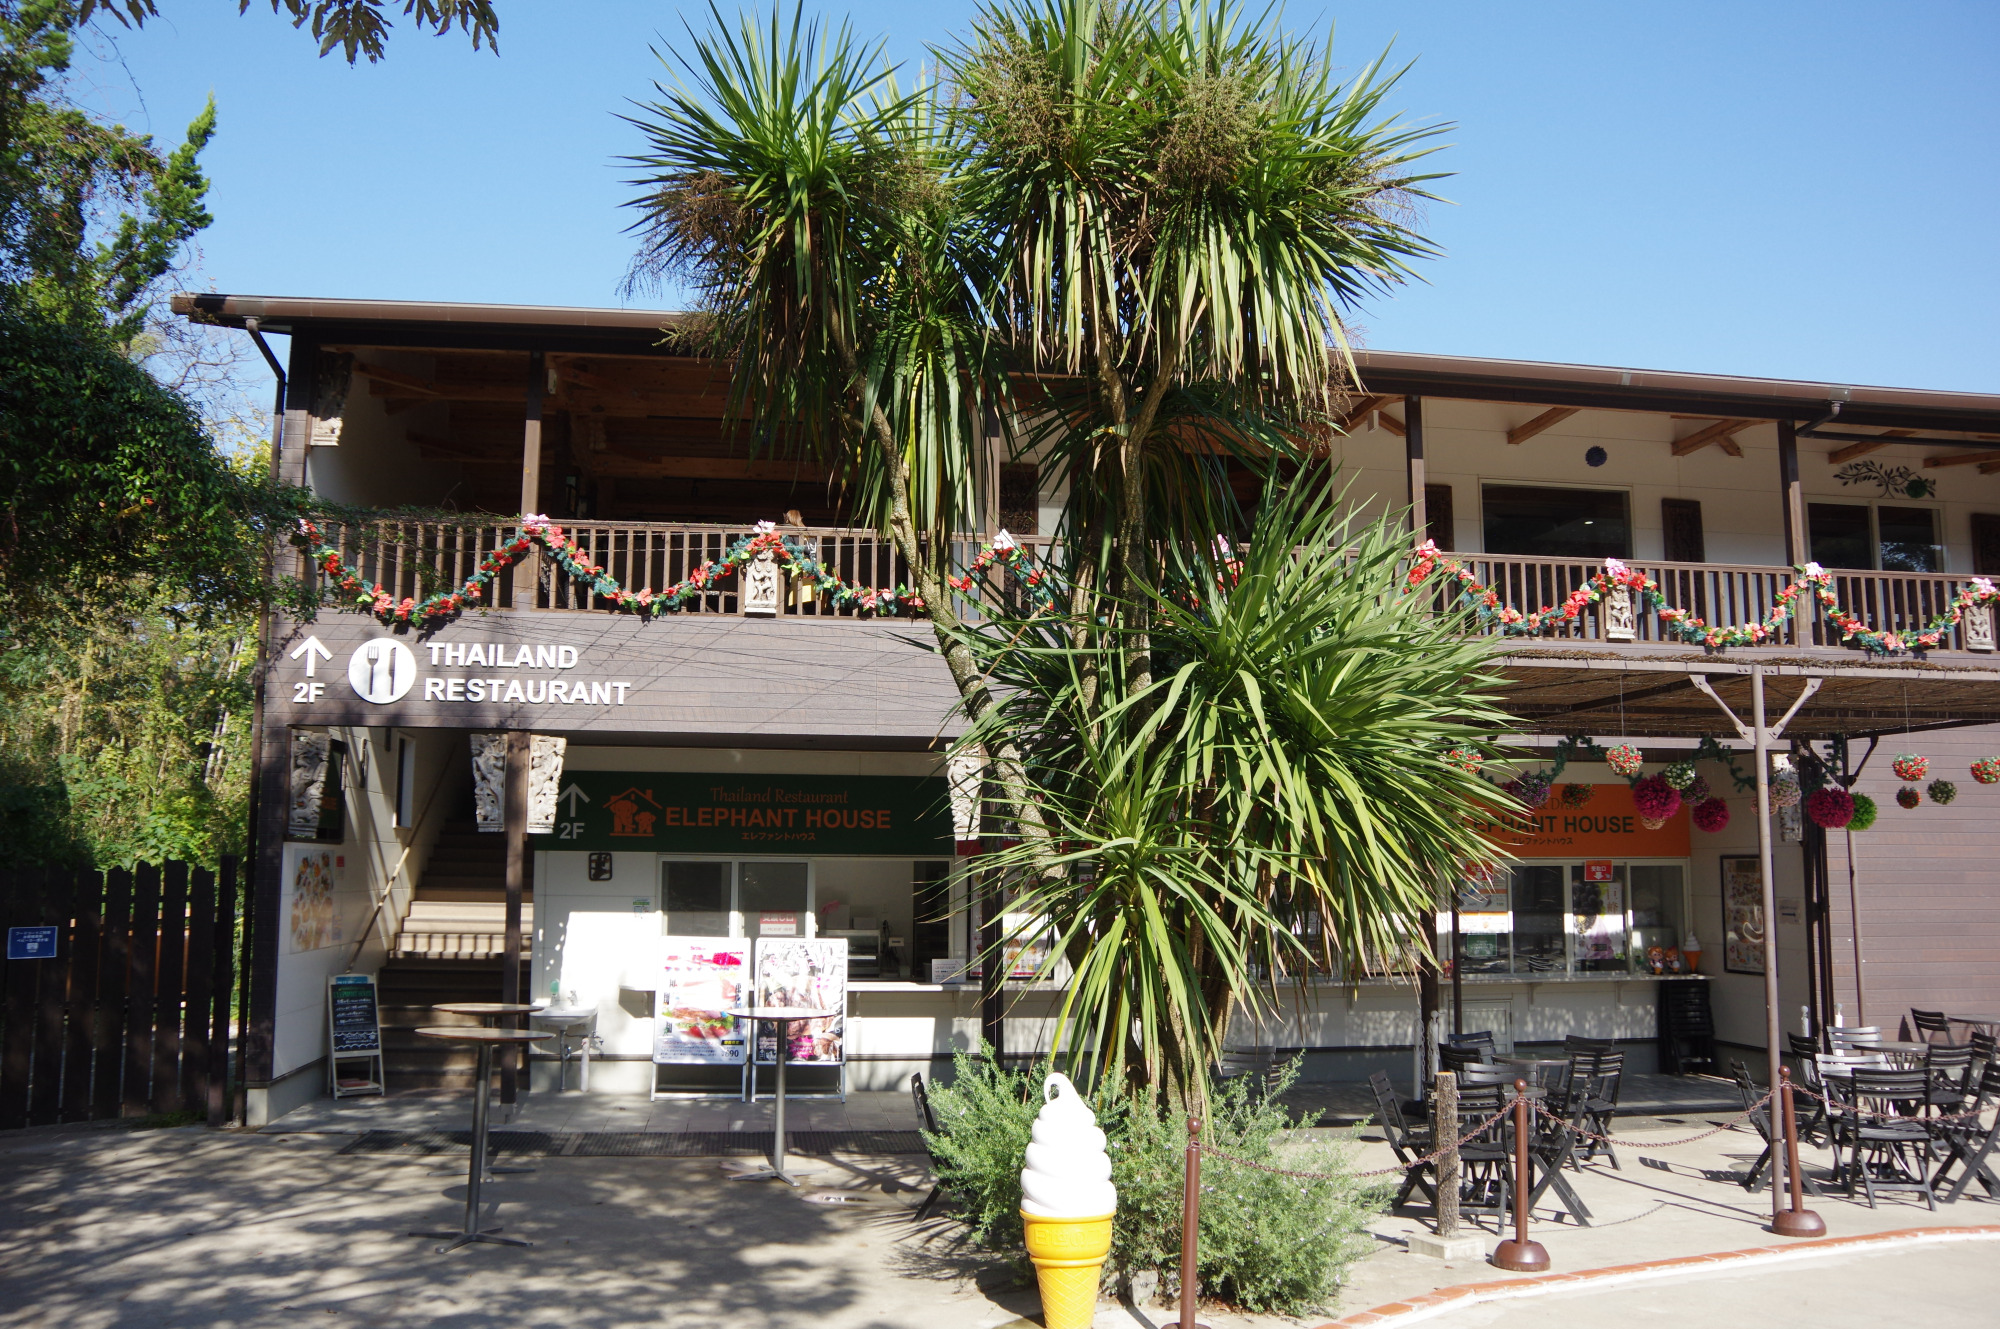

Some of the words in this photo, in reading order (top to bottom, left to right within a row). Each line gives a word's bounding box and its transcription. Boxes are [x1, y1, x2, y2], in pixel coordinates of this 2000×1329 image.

[425, 641, 578, 668] THAILAND
[292, 682, 325, 703] 2F
[424, 678, 631, 705] RESTAURANT
[709, 786, 771, 803] Thailand
[775, 788, 849, 804] Restaurant
[665, 806, 799, 828] ELEPHANT
[806, 809, 891, 829] HOUSE
[1564, 816, 1634, 834] HOUSE
[559, 822, 585, 840] 2F
[740, 831, 816, 842] エレファントハウス
[1511, 837, 1574, 846] エレファントハウス
